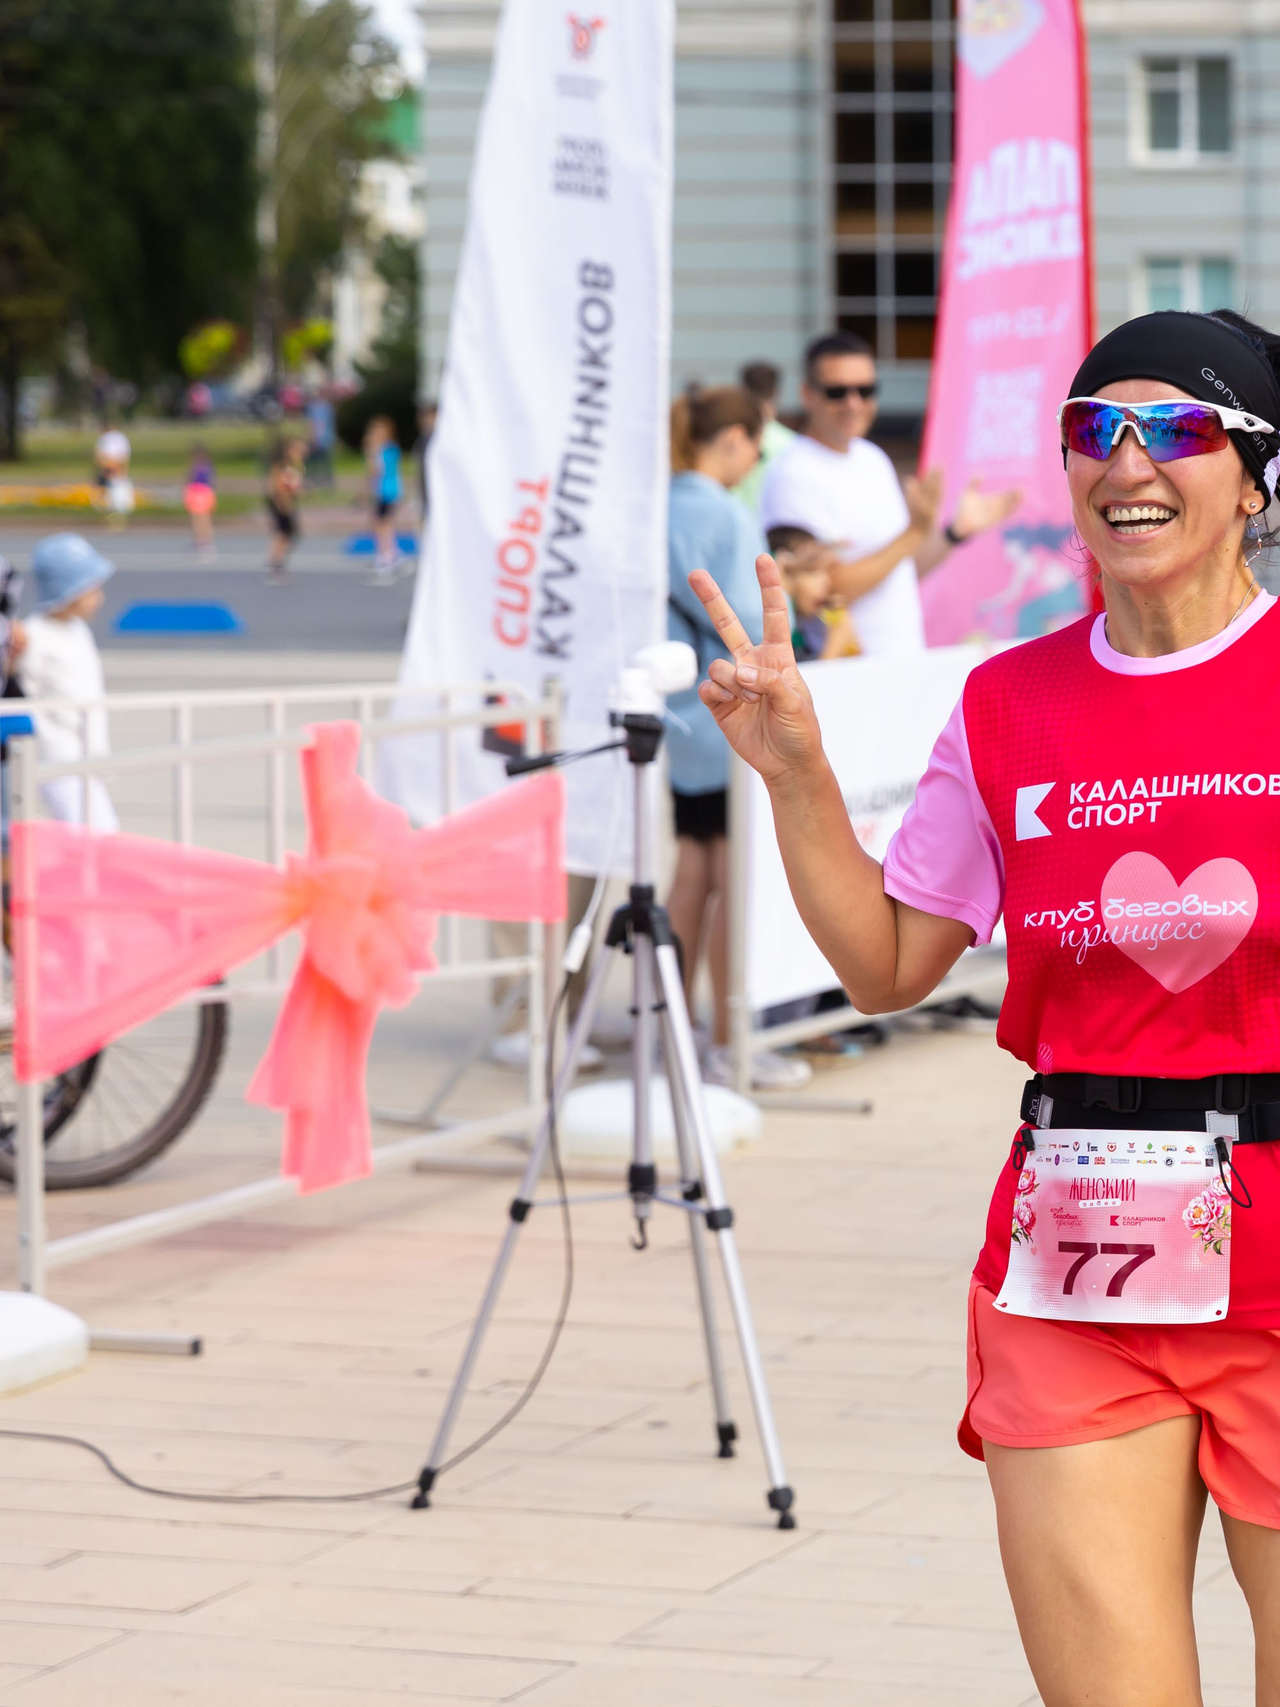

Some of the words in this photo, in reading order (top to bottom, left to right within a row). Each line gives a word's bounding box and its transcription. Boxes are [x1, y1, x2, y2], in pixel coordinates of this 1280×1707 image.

[1067, 801, 1162, 829] СПОРТ
[1024, 900, 1096, 929] клуб
[1104, 893, 1250, 920] беговых
[1060, 921, 1206, 965] принцесс
[1069, 1177, 1136, 1201] ЖЕНСКИЙ
[1058, 1241, 1156, 1298] 77
